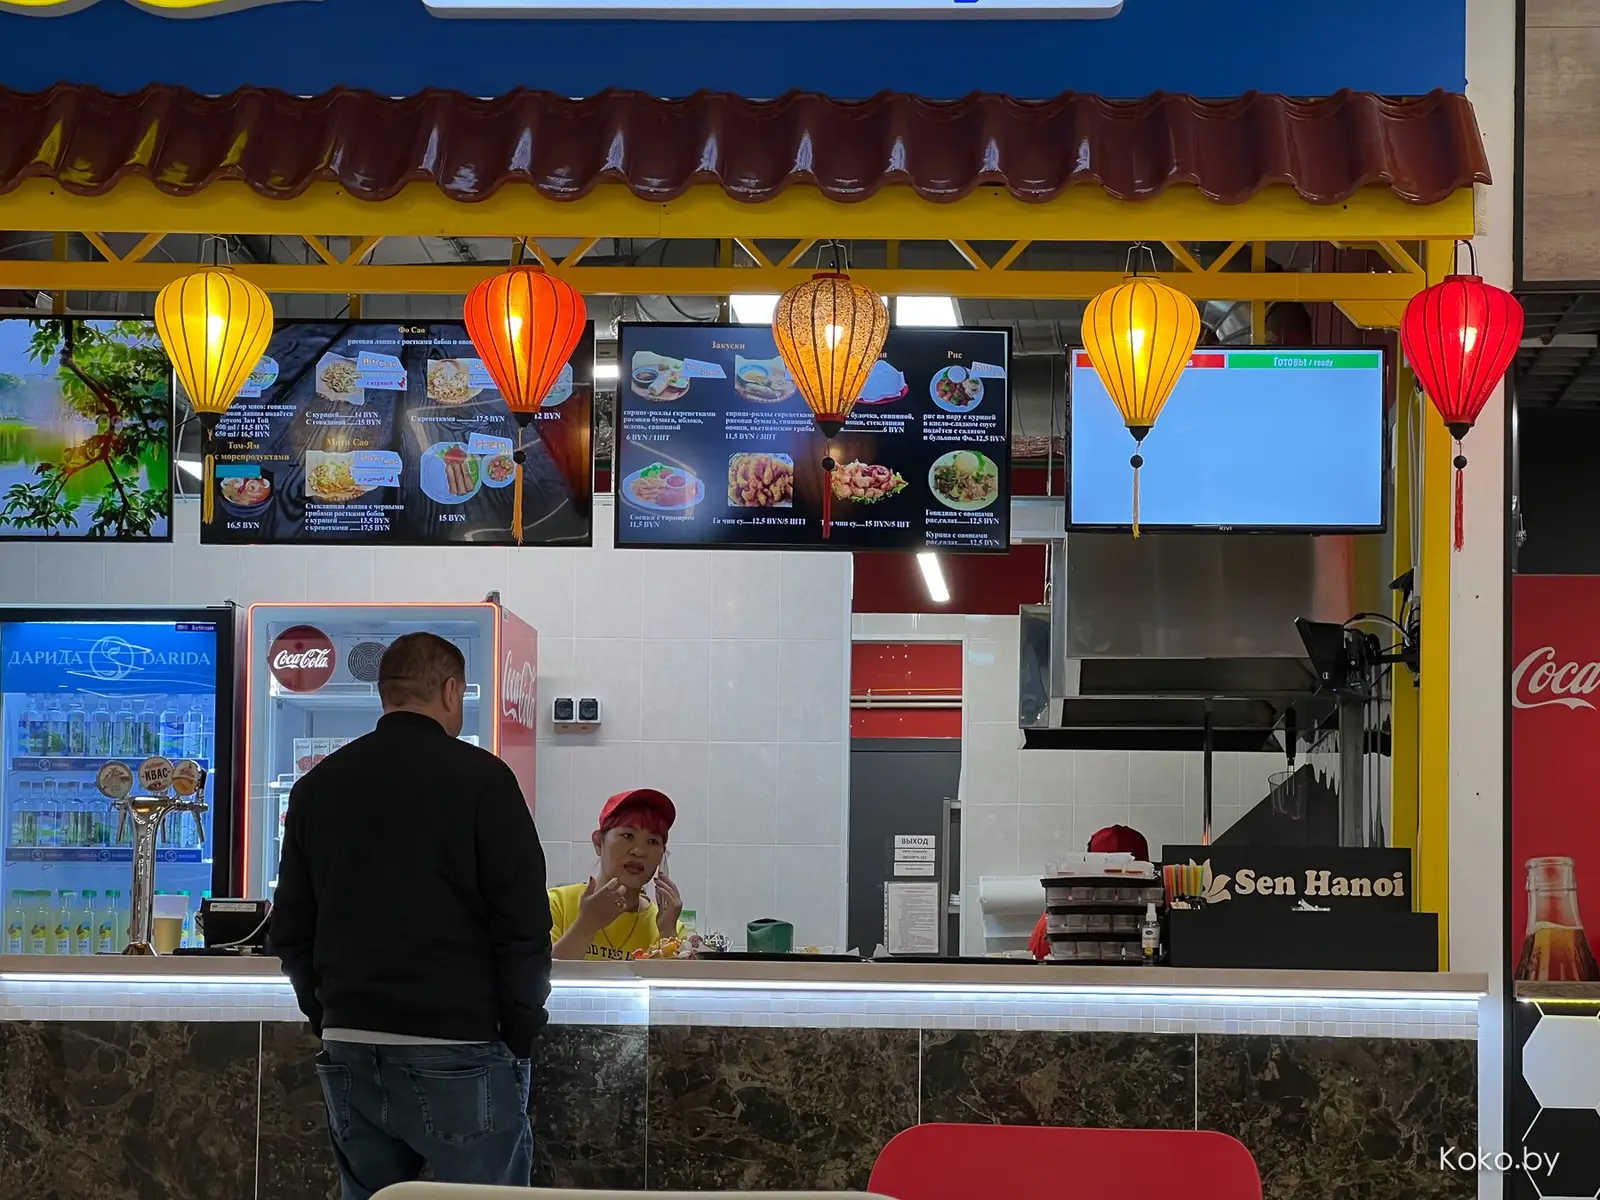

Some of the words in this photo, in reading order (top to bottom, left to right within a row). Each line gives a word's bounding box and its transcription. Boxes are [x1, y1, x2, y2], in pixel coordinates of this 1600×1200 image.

[711, 341, 745, 350] Закуски
[948, 351, 962, 359] Рис
[1314, 359, 1333, 367] ready
[227, 441, 260, 450] Том-Ям
[7, 650, 83, 666] ДАРИДА
[142, 652, 211, 665] DARIDA
[273, 648, 329, 670] Coca-Cola
[1512, 646, 1600, 711] Coca
[145, 767, 168, 781] КВАС
[902, 838, 928, 846] ВЫХОД
[1235, 869, 1296, 896] Sen
[1306, 869, 1405, 897] Hanoi
